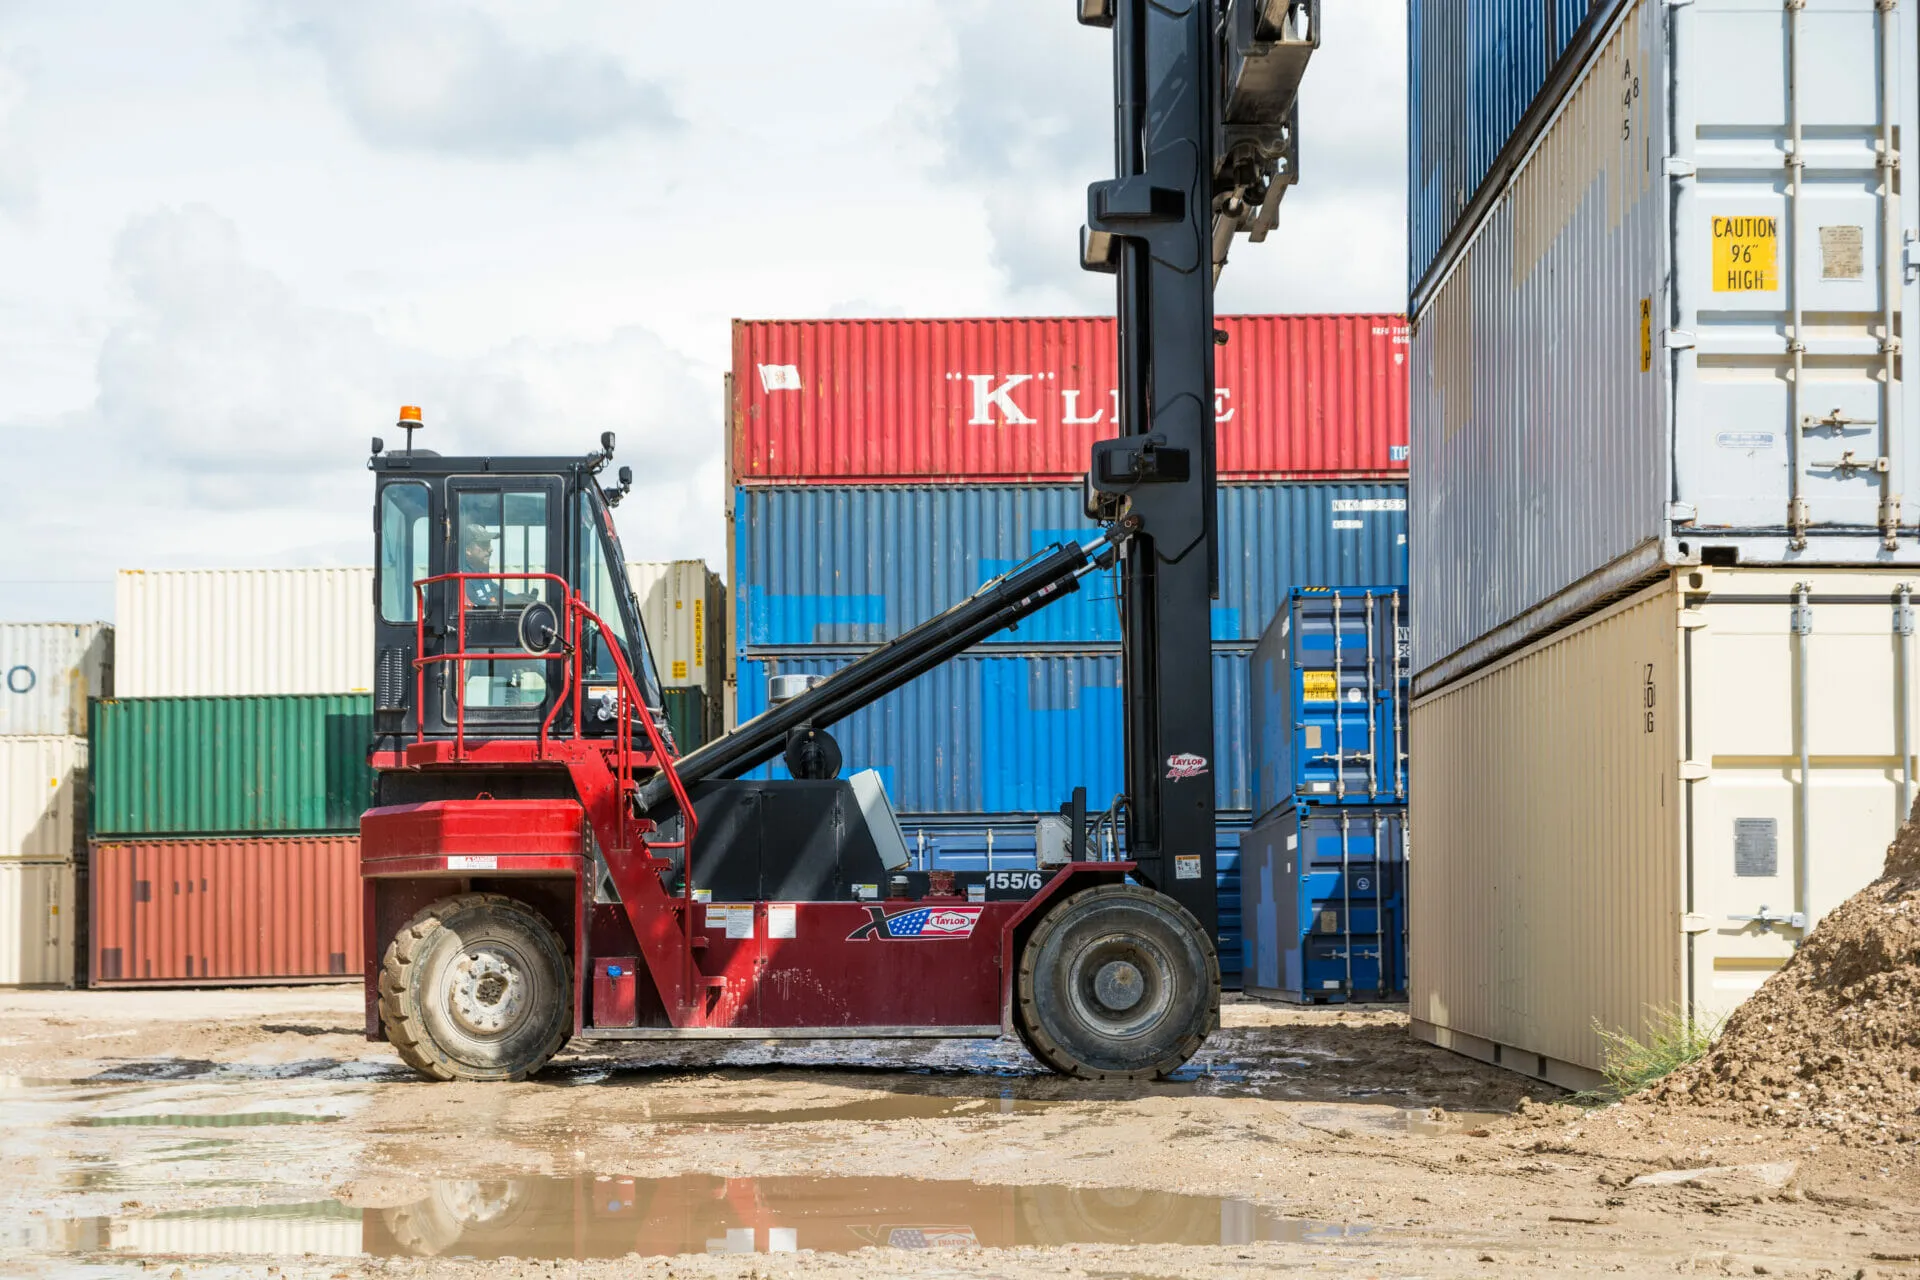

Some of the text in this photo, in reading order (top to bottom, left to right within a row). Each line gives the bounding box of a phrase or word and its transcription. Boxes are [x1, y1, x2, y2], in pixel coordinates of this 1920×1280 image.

[1714, 218, 1777, 238] CAUTION
[1728, 270, 1764, 290] HIGH
[1171, 755, 1203, 765] TAYLOR
[986, 873, 1042, 889] 155/6
[935, 914, 966, 926] TAYLOR
